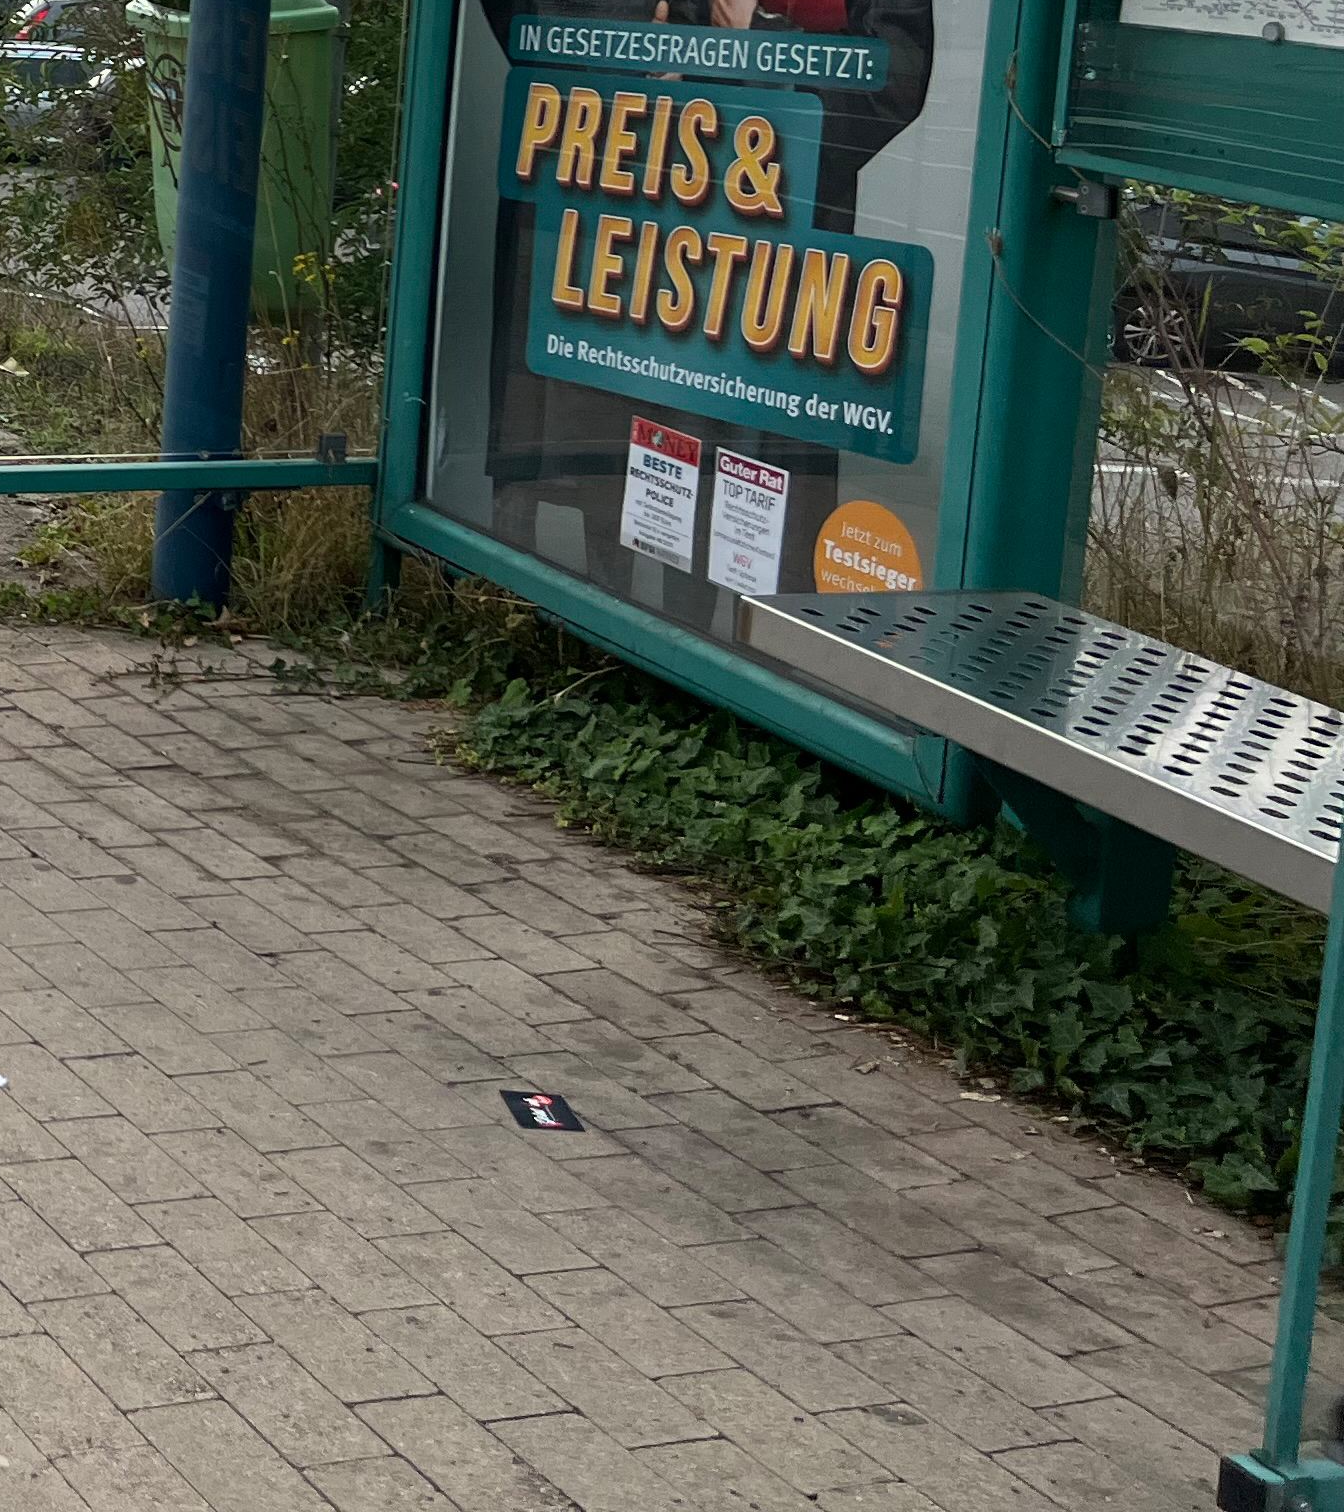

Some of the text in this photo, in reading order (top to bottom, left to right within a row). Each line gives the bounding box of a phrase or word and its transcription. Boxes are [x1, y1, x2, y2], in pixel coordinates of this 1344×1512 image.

[519, 25, 874, 80] IN GESETZESFRAGEN GESETZT:
[515, 82, 719, 206] PREIS
[551, 208, 904, 375] LEISTUNG
[546, 333, 894, 435] Die Rechtsschutzversicherung der WGV.
[643, 453, 683, 480] BESTE
[719, 455, 783, 491] Guter Rat
[723, 478, 776, 511] TOP TARIF
[823, 538, 917, 592] Testsieger
[840, 521, 903, 558] Jetzt zum
